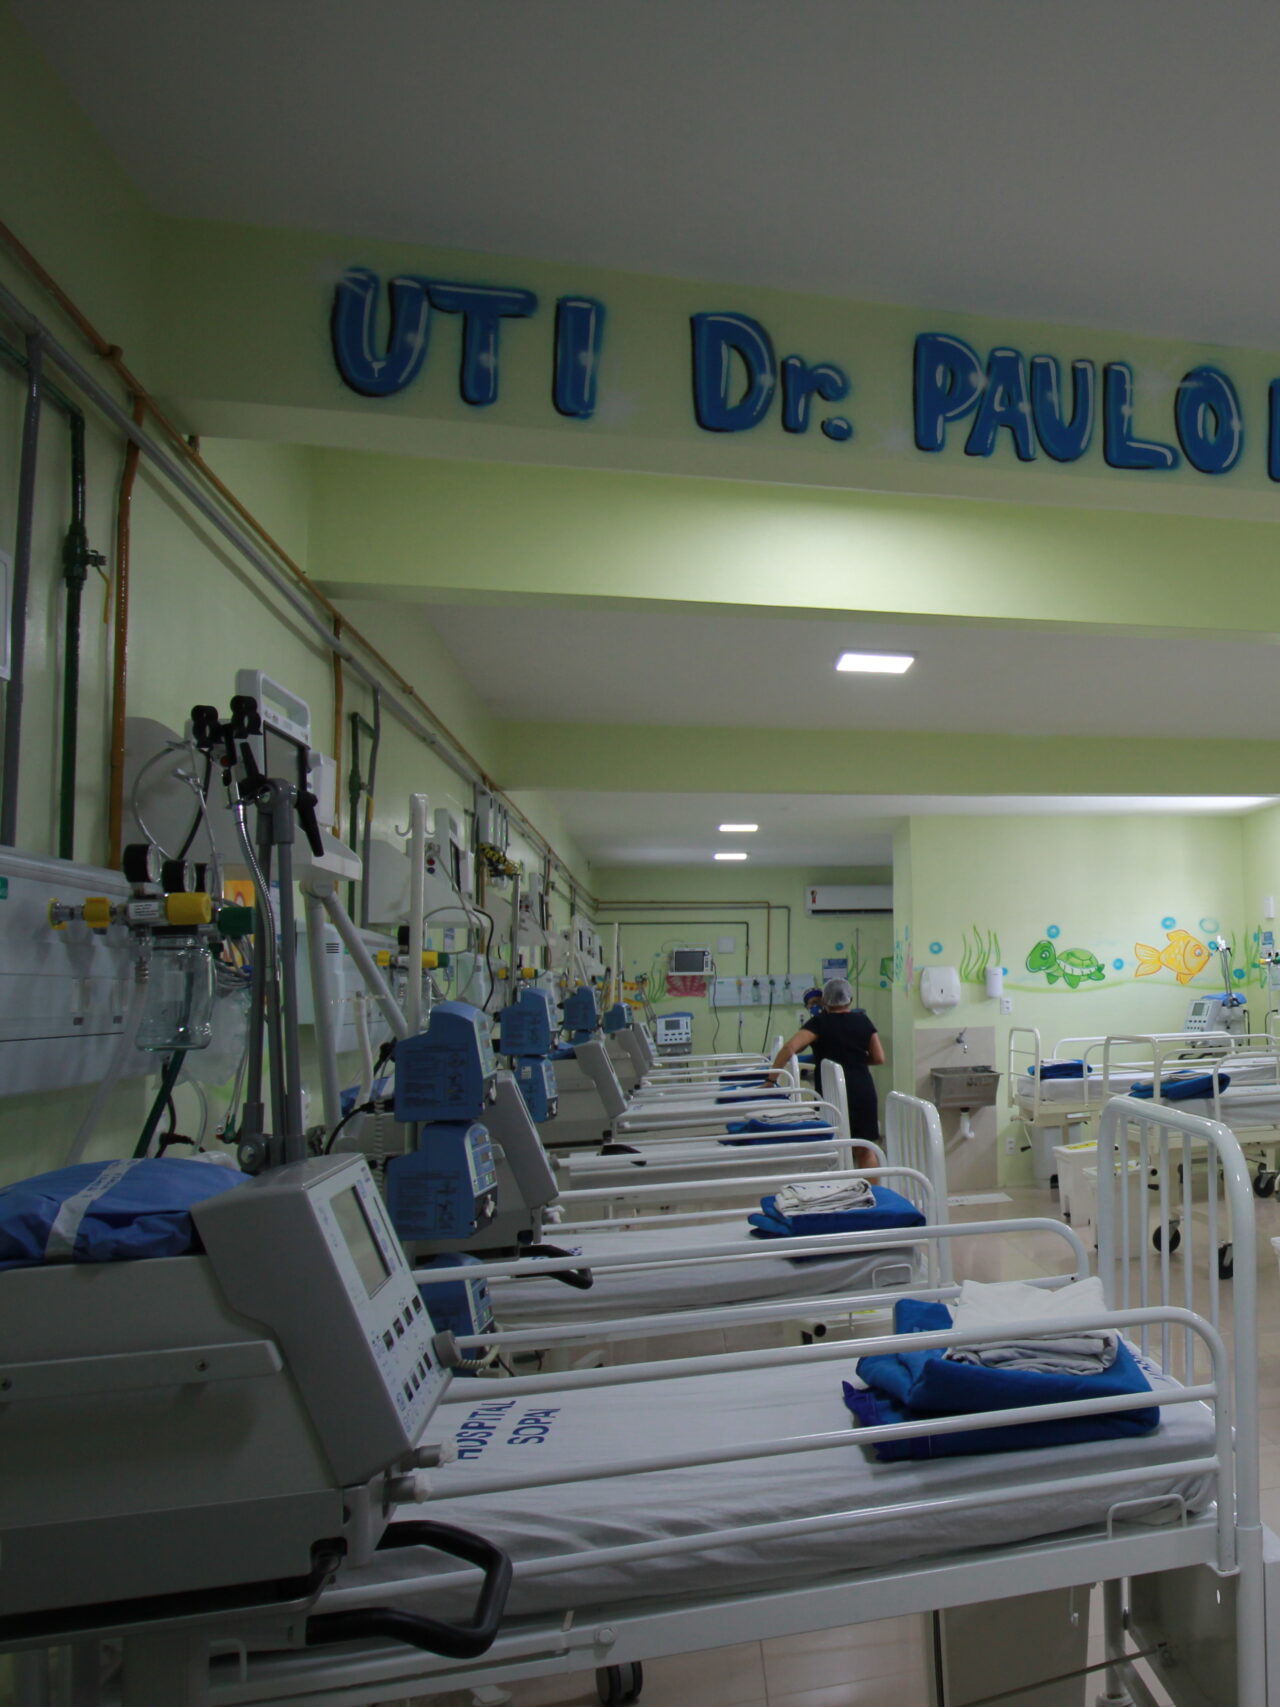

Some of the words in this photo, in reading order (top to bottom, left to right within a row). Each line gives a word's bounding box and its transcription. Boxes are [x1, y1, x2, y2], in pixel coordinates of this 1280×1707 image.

[331, 267, 606, 420] UTI
[690, 311, 854, 442] Dr.
[914, 332, 1245, 475] PAULO
[507, 1408, 561, 1445] SOPAI
